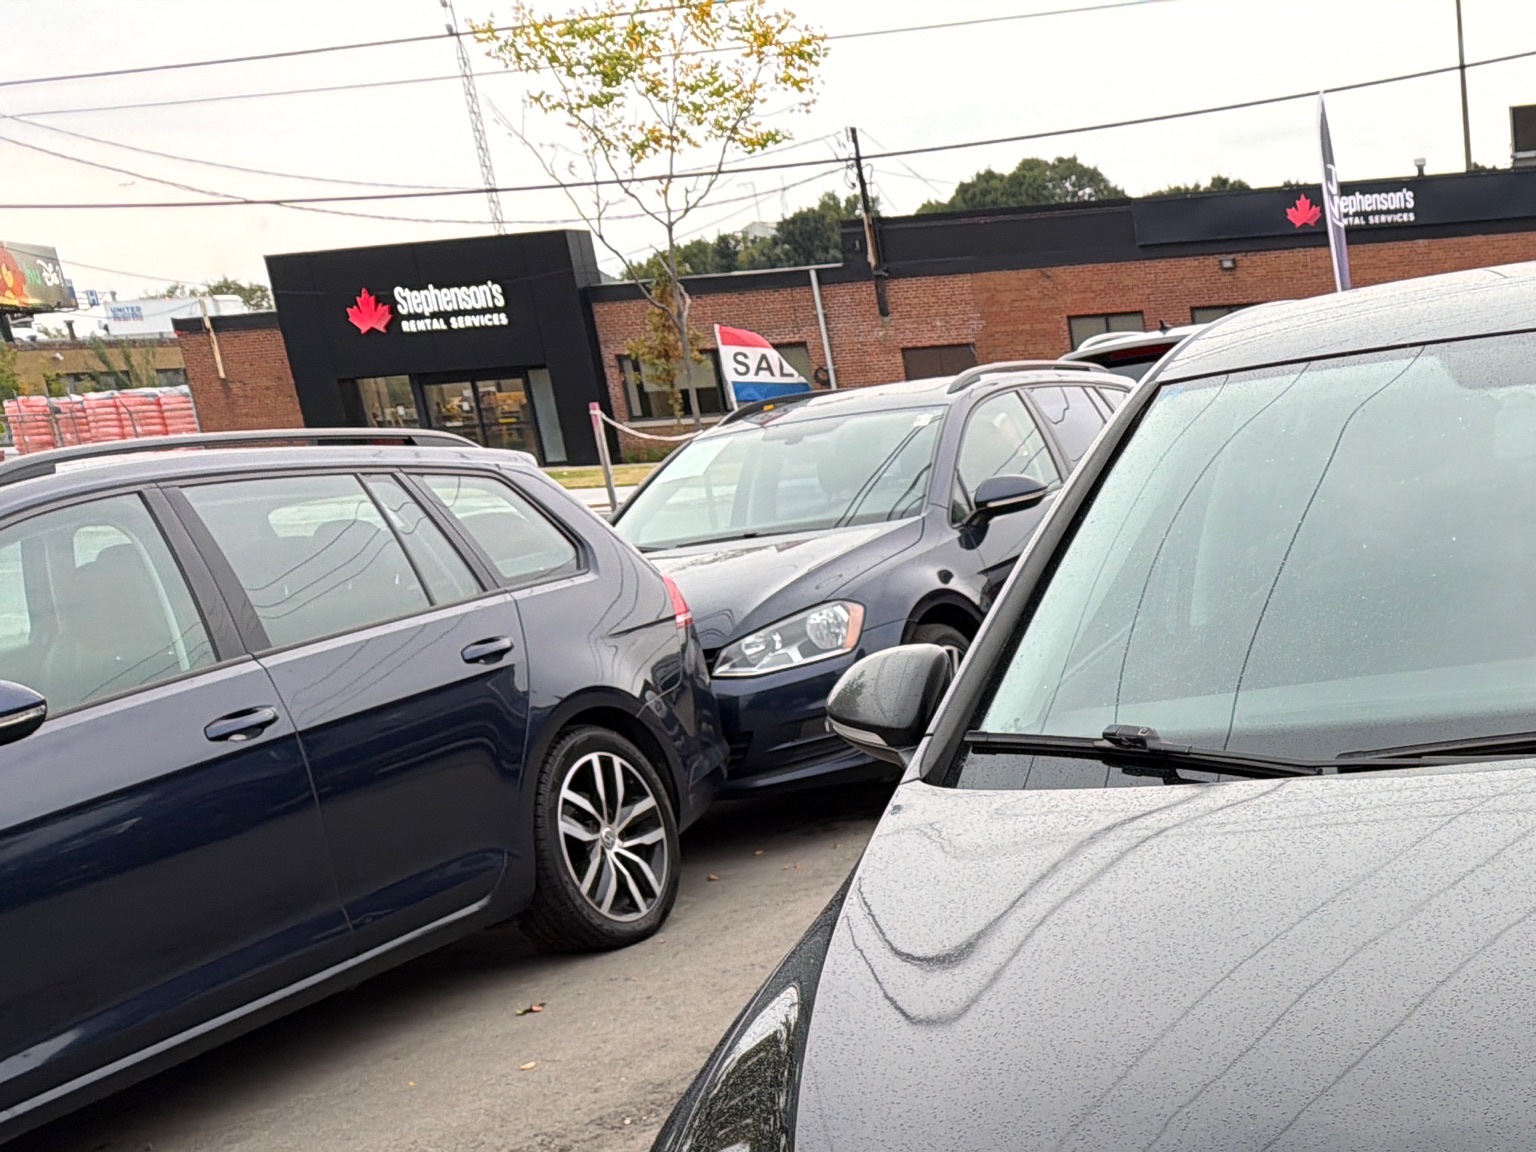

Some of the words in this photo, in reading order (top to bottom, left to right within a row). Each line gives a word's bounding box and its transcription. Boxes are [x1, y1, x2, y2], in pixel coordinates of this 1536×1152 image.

[1340, 187, 1415, 213] ephenson's
[1343, 214, 1366, 226] NTAL
[1368, 212, 1415, 224] SERVICES
[393, 280, 505, 316] Stephenson's
[401, 318, 448, 332] RENTAL
[450, 313, 508, 329] SERVICES
[732, 351, 794, 377] SAL
